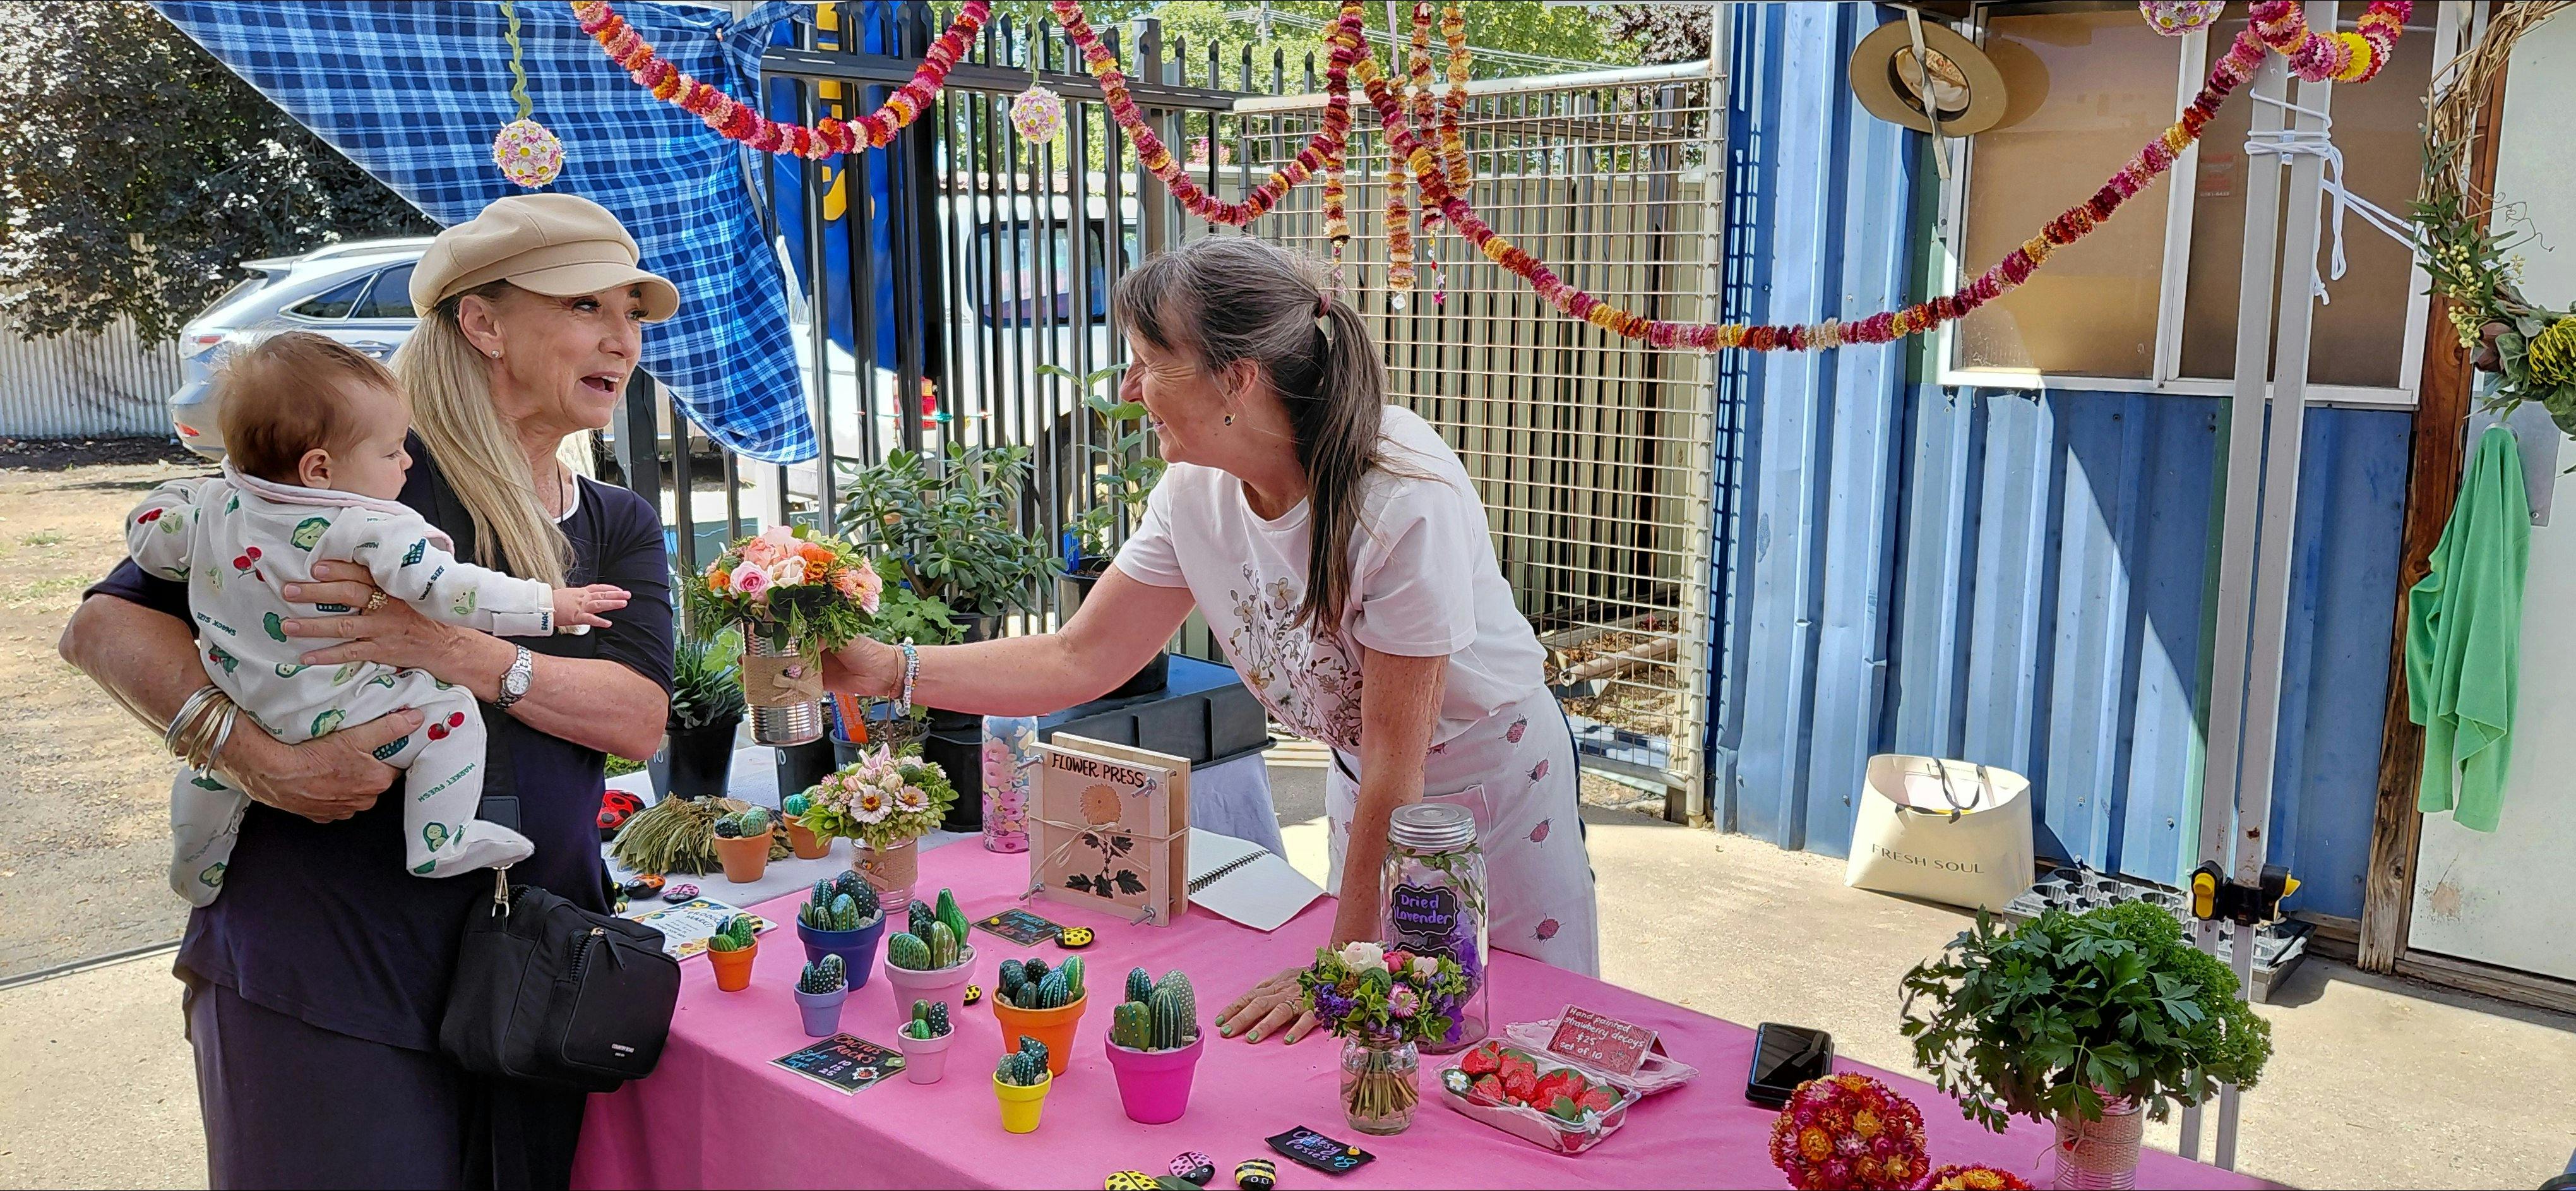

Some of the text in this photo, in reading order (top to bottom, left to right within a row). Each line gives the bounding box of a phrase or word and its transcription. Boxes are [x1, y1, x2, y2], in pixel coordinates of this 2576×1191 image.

[430, 565, 444, 581] SIZE
[196, 611, 237, 637] SNACK SIZE
[1051, 753, 1145, 788] FLOWER PRESS
[417, 762, 476, 803] MARKET FRESH
[1871, 843, 1984, 874] FRESH SOUL
[1400, 894, 1440, 909] Dried
[685, 914, 714, 928] MARKET
[687, 911, 720, 923] PRODUC
[1395, 906, 1452, 925] Lavender
[1569, 1007, 1631, 1033] Hand painted
[1563, 1015, 1645, 1050] strawberry decoys
[1575, 1032, 1597, 1046] $25
[833, 1036, 884, 1055] CACTUS
[835, 1044, 877, 1064] ROCKS
[1559, 1040, 1603, 1060] set of 10
[818, 1068, 837, 1076] 25
[1285, 1138, 1358, 1168] Posies $8
